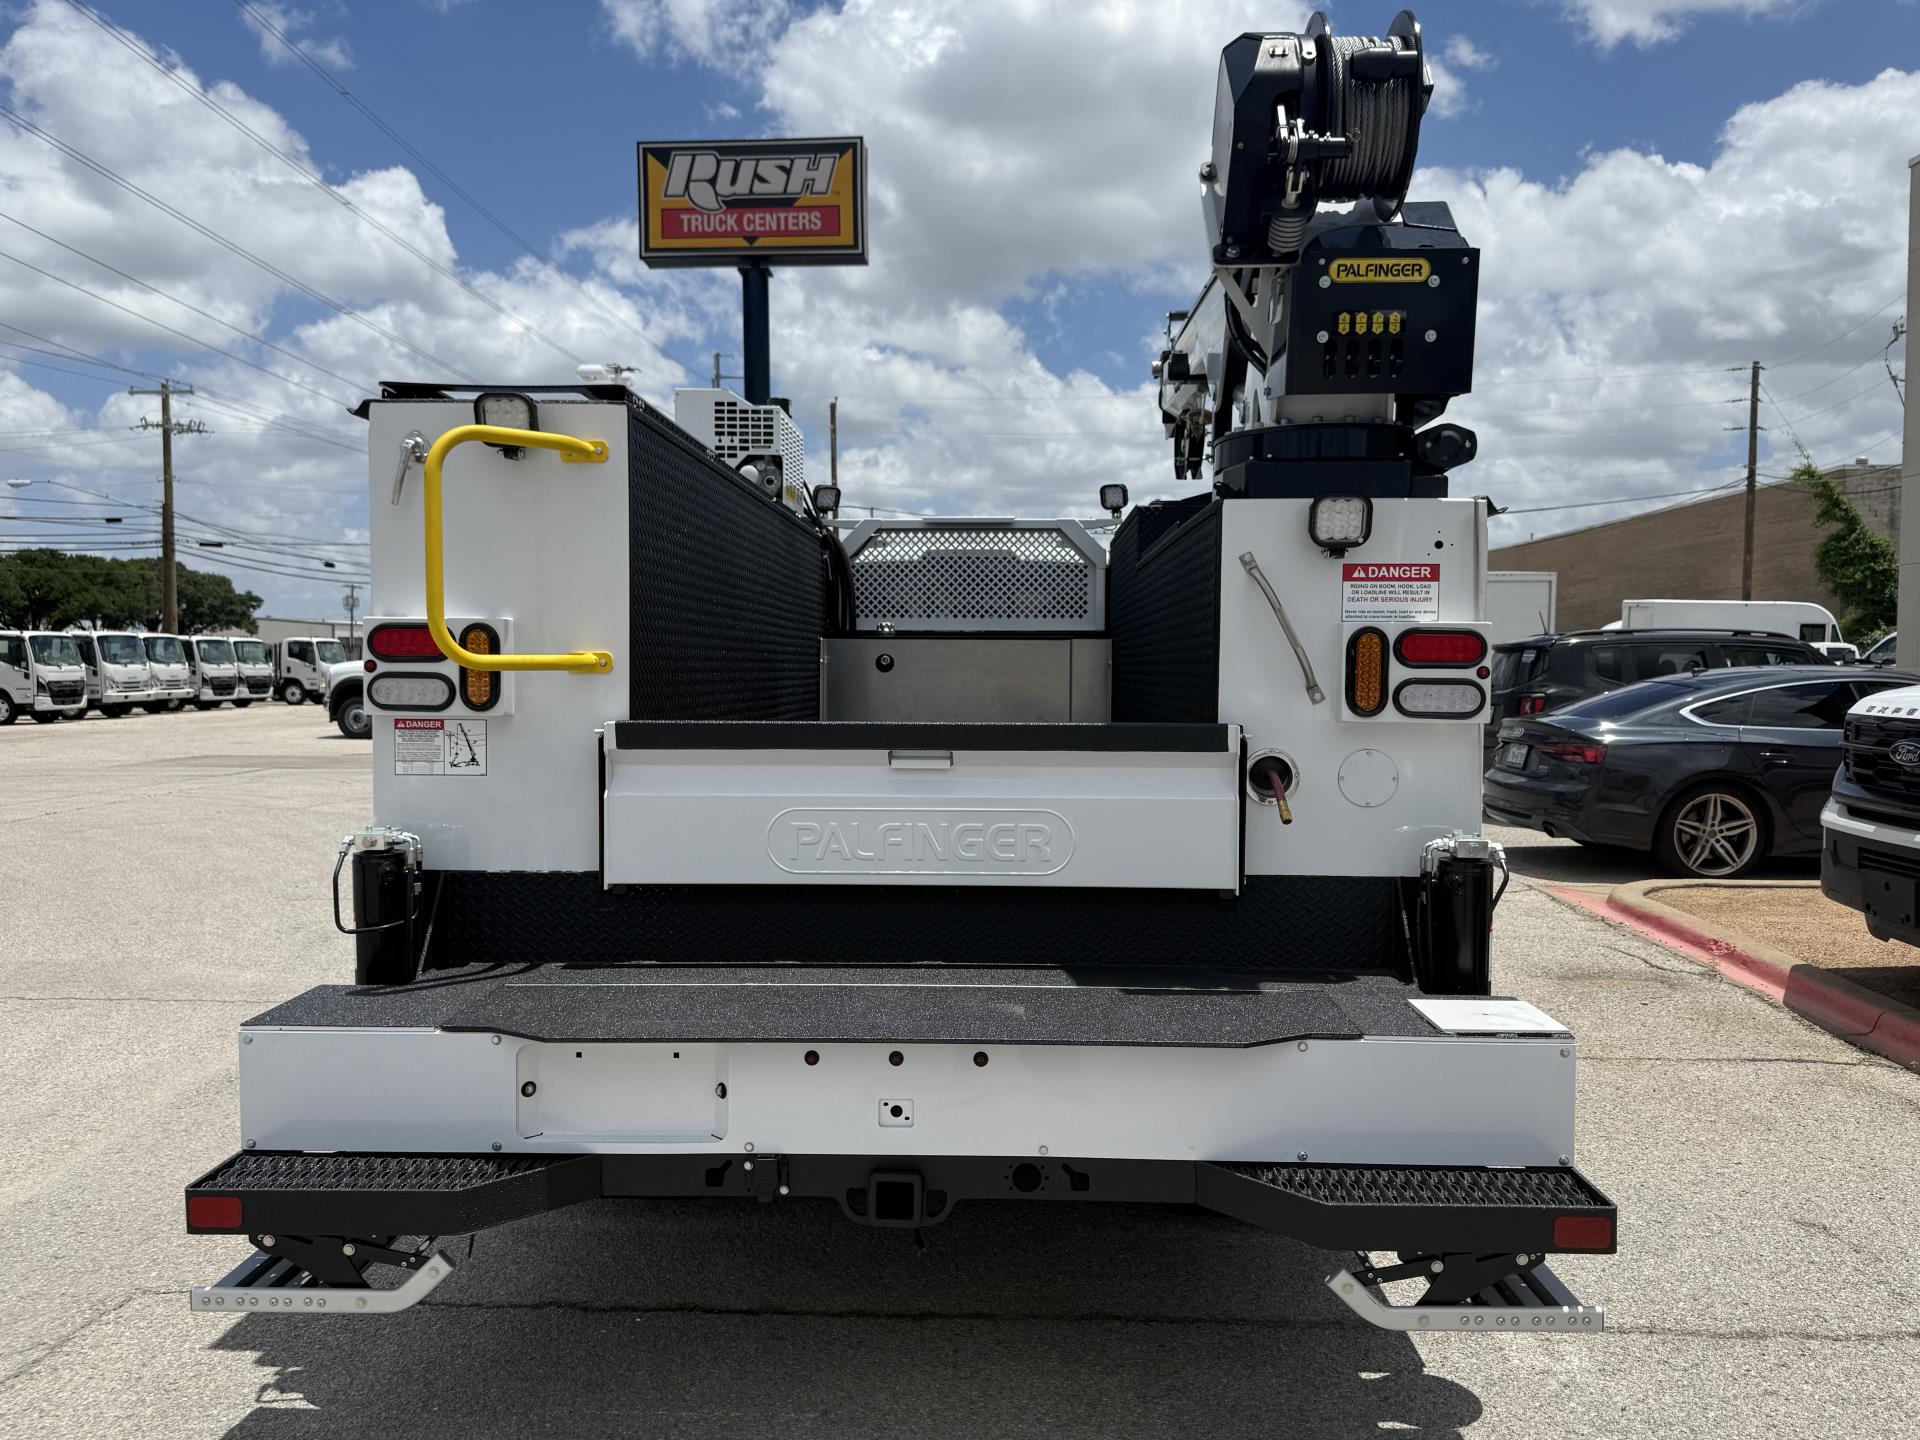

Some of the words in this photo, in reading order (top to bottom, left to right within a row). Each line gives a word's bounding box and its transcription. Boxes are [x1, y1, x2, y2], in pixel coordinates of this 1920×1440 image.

[680, 213, 739, 232] TRUCK
[743, 211, 822, 231] CENTERS
[1336, 263, 1423, 278] PALFINGER
[1368, 566, 1431, 578] DANGER
[406, 720, 441, 728] DANGER
[790, 822, 1050, 862] PALFINGER
